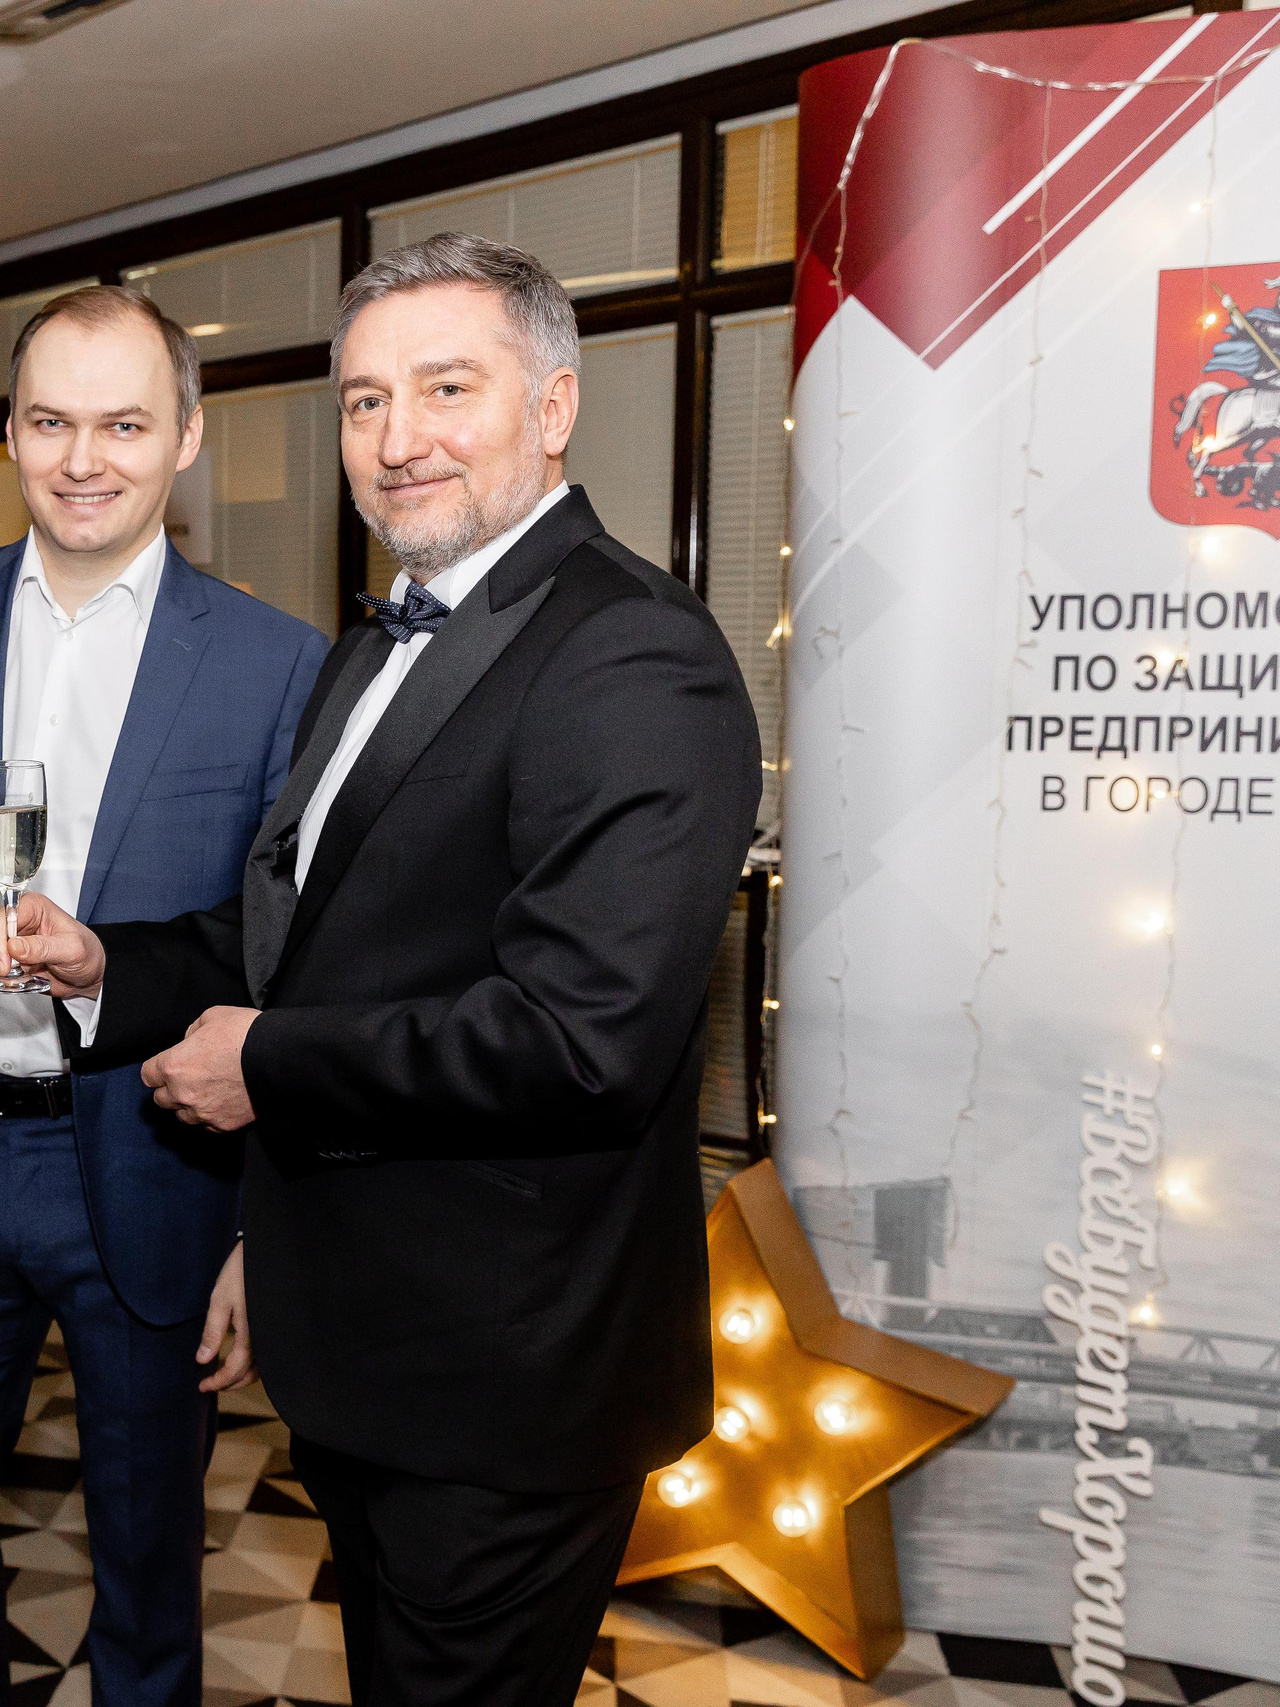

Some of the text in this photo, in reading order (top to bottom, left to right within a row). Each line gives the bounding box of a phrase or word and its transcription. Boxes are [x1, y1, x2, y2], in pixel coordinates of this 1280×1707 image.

[1029, 591, 1280, 631] УПОЛНОМ
[1052, 654, 1279, 699] ПО ЗАЩИ
[1040, 775, 1274, 823] В ГОРОДЕ
